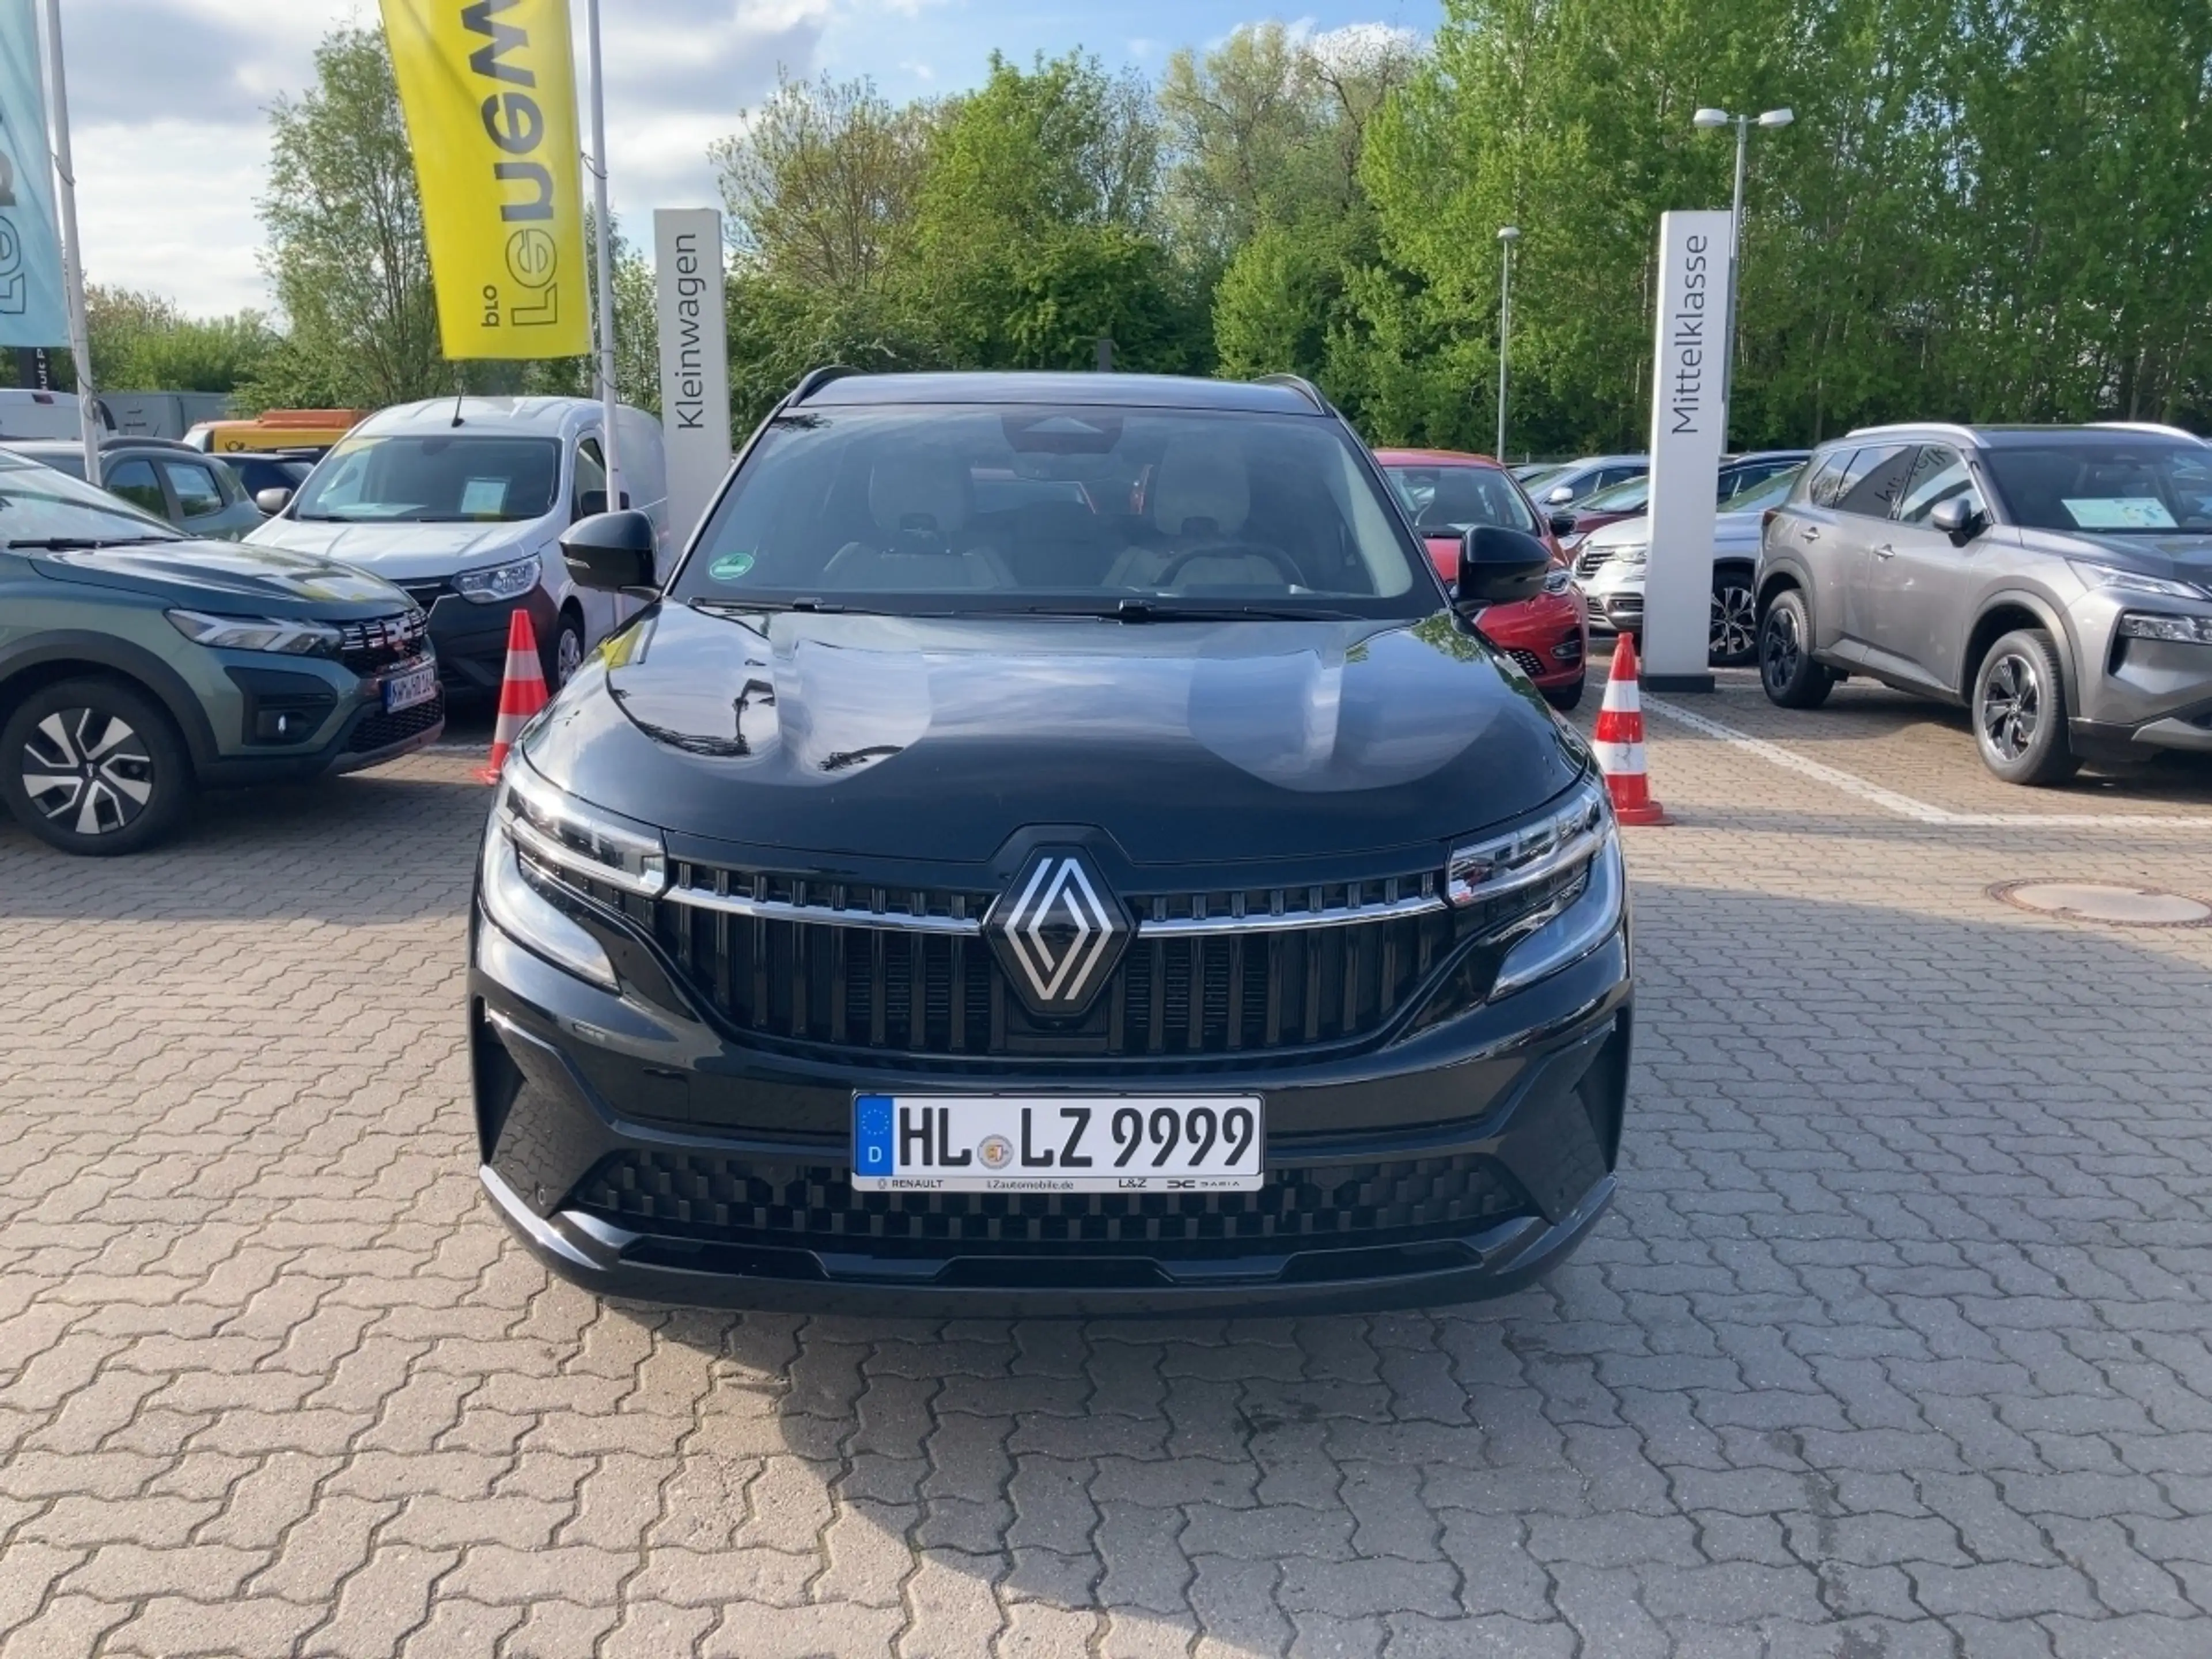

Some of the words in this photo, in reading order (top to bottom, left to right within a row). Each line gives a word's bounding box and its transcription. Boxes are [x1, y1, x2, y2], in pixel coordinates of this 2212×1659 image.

[675, 233, 706, 430] Kleinwagen
[1672, 235, 1708, 434] Mittelklasse
[868, 1146, 882, 1162] D
[899, 1107, 972, 1166] HL
[1021, 1107, 1093, 1166] LZ
[1111, 1107, 1255, 1167] 9999
[892, 1179, 944, 1188] RENAULT
[1119, 1178, 1147, 1188] L&Z
